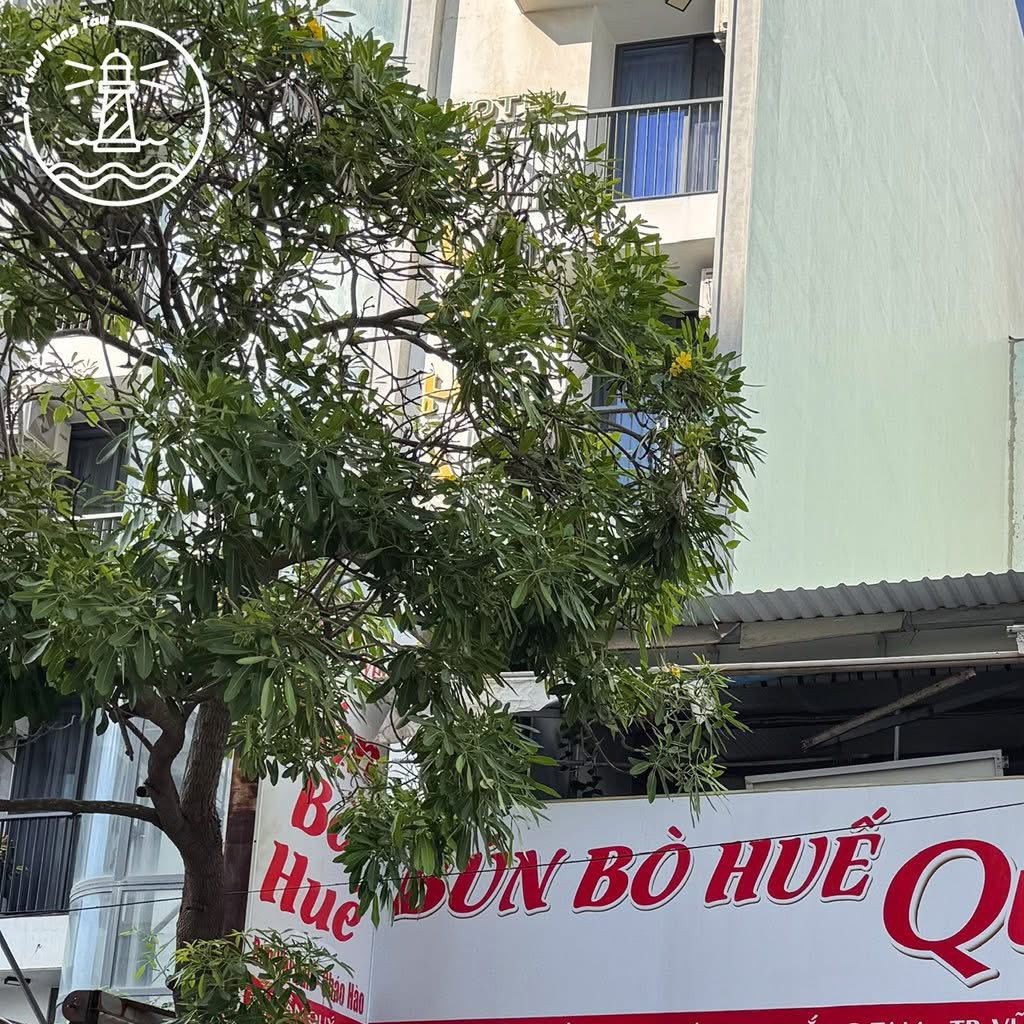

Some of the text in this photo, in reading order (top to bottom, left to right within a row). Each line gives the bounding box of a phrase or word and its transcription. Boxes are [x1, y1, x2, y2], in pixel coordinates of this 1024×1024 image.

[573, 825, 695, 914] BÒ
[704, 806, 892, 908] HUẾ
[347, 981, 365, 1015] Hào
